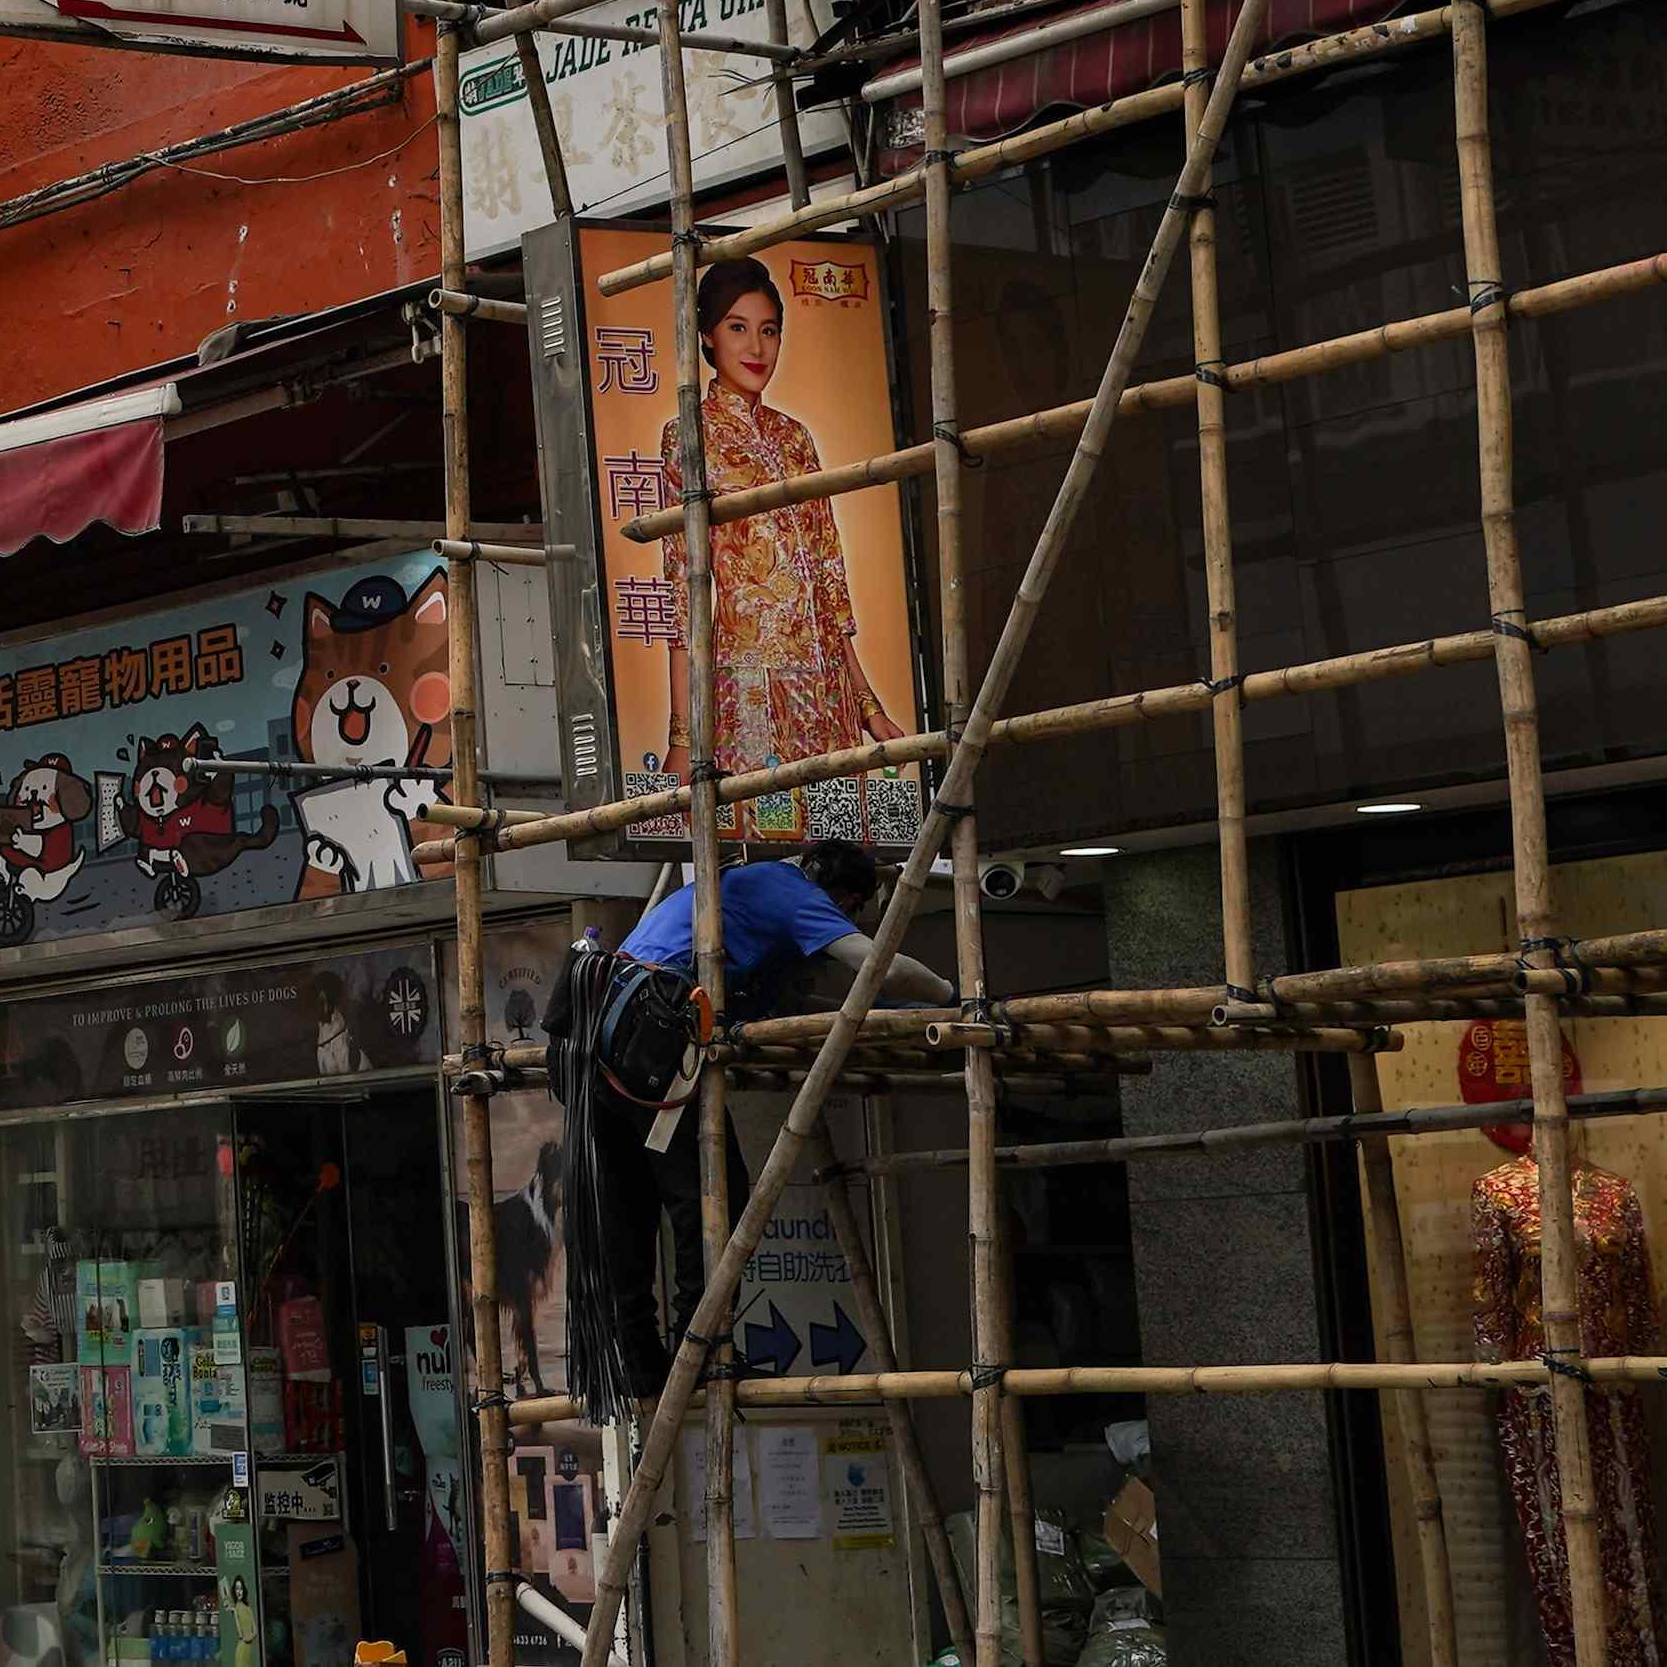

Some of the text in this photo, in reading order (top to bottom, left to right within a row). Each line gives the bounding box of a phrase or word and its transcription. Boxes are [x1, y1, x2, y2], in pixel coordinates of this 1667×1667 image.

[546, 33, 612, 85] JADE
[802, 267, 856, 290] 冠南華
[594, 324, 679, 648] 冠南華
[362, 595, 382, 609] W
[162, 741, 172, 749] W
[47, 756, 59, 766] W
[178, 816, 192, 828] W
[72, 1012, 86, 1027] TO
[88, 1007, 132, 1026] IMPROVE
[144, 996, 193, 1019] PROLONG
[195, 995, 217, 1012] THE
[218, 989, 250, 1008] LIVES
[251, 989, 267, 1004] OF
[268, 986, 298, 1002] DOGS
